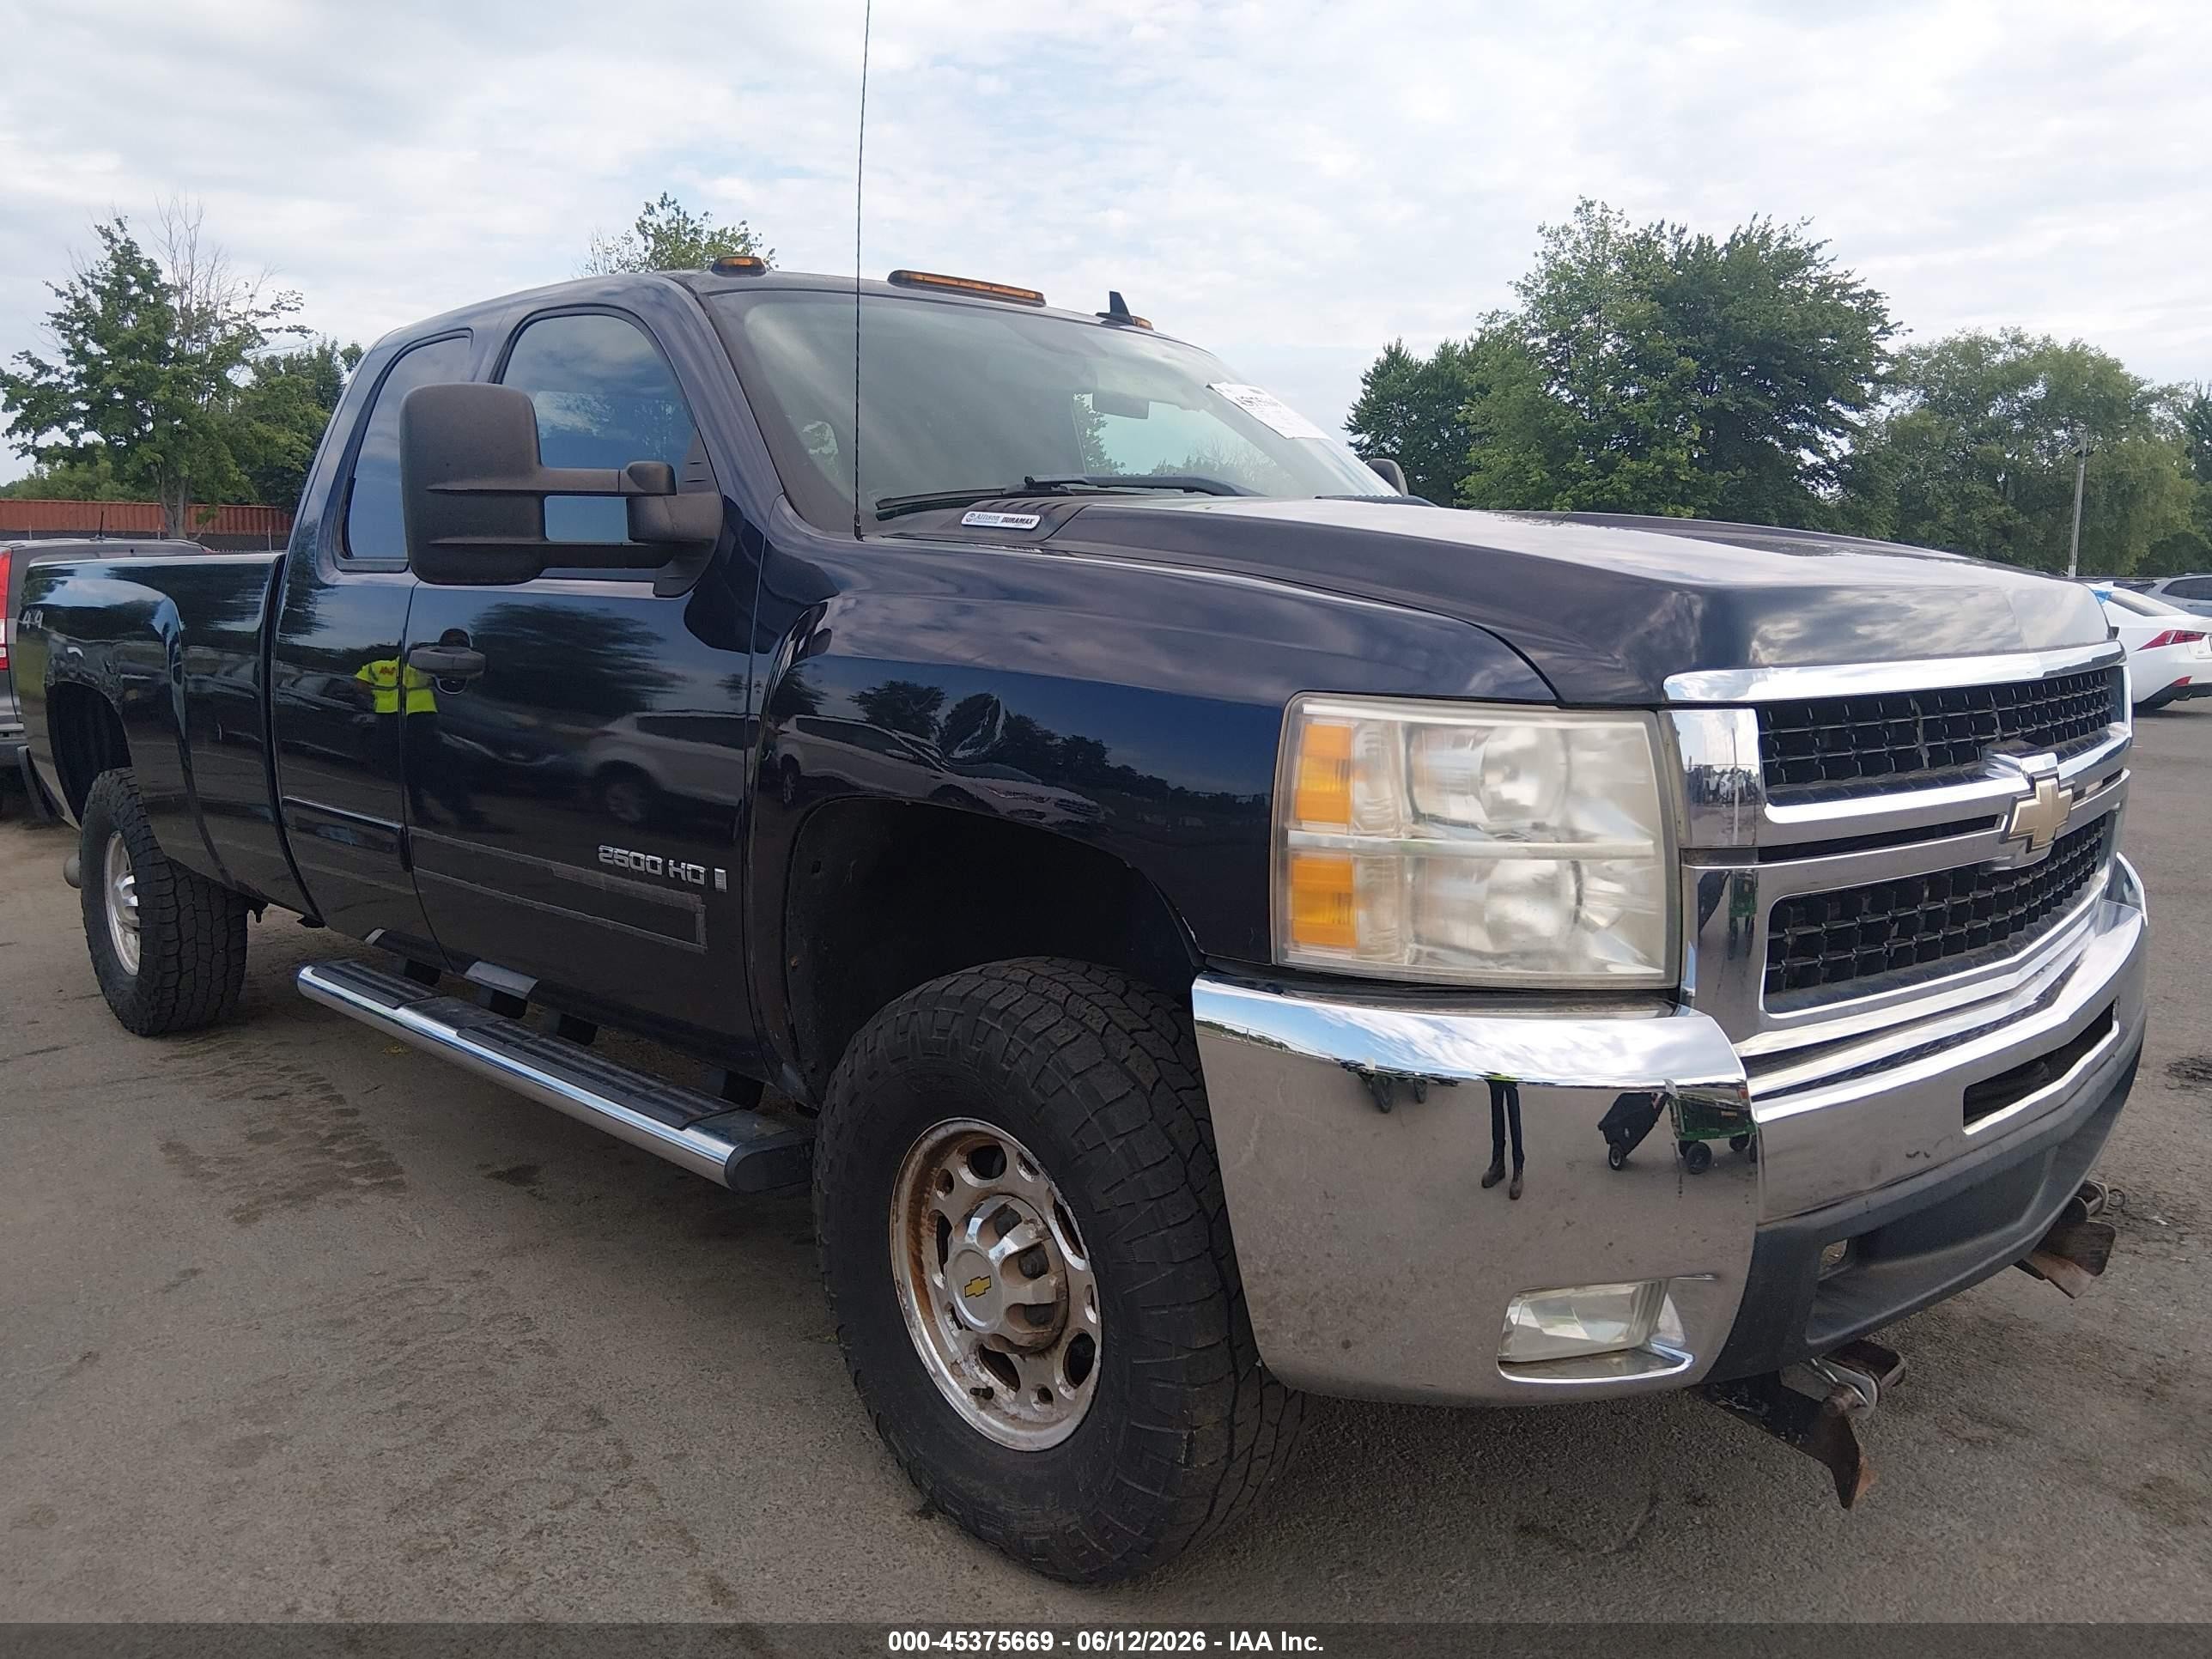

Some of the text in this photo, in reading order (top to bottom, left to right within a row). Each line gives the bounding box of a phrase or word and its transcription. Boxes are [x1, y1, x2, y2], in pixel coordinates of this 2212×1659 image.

[1001, 516, 1034, 525] DURAMAX
[22, 610, 44, 629] 44
[599, 845, 663, 876] 2500
[668, 859, 706, 885] HD
